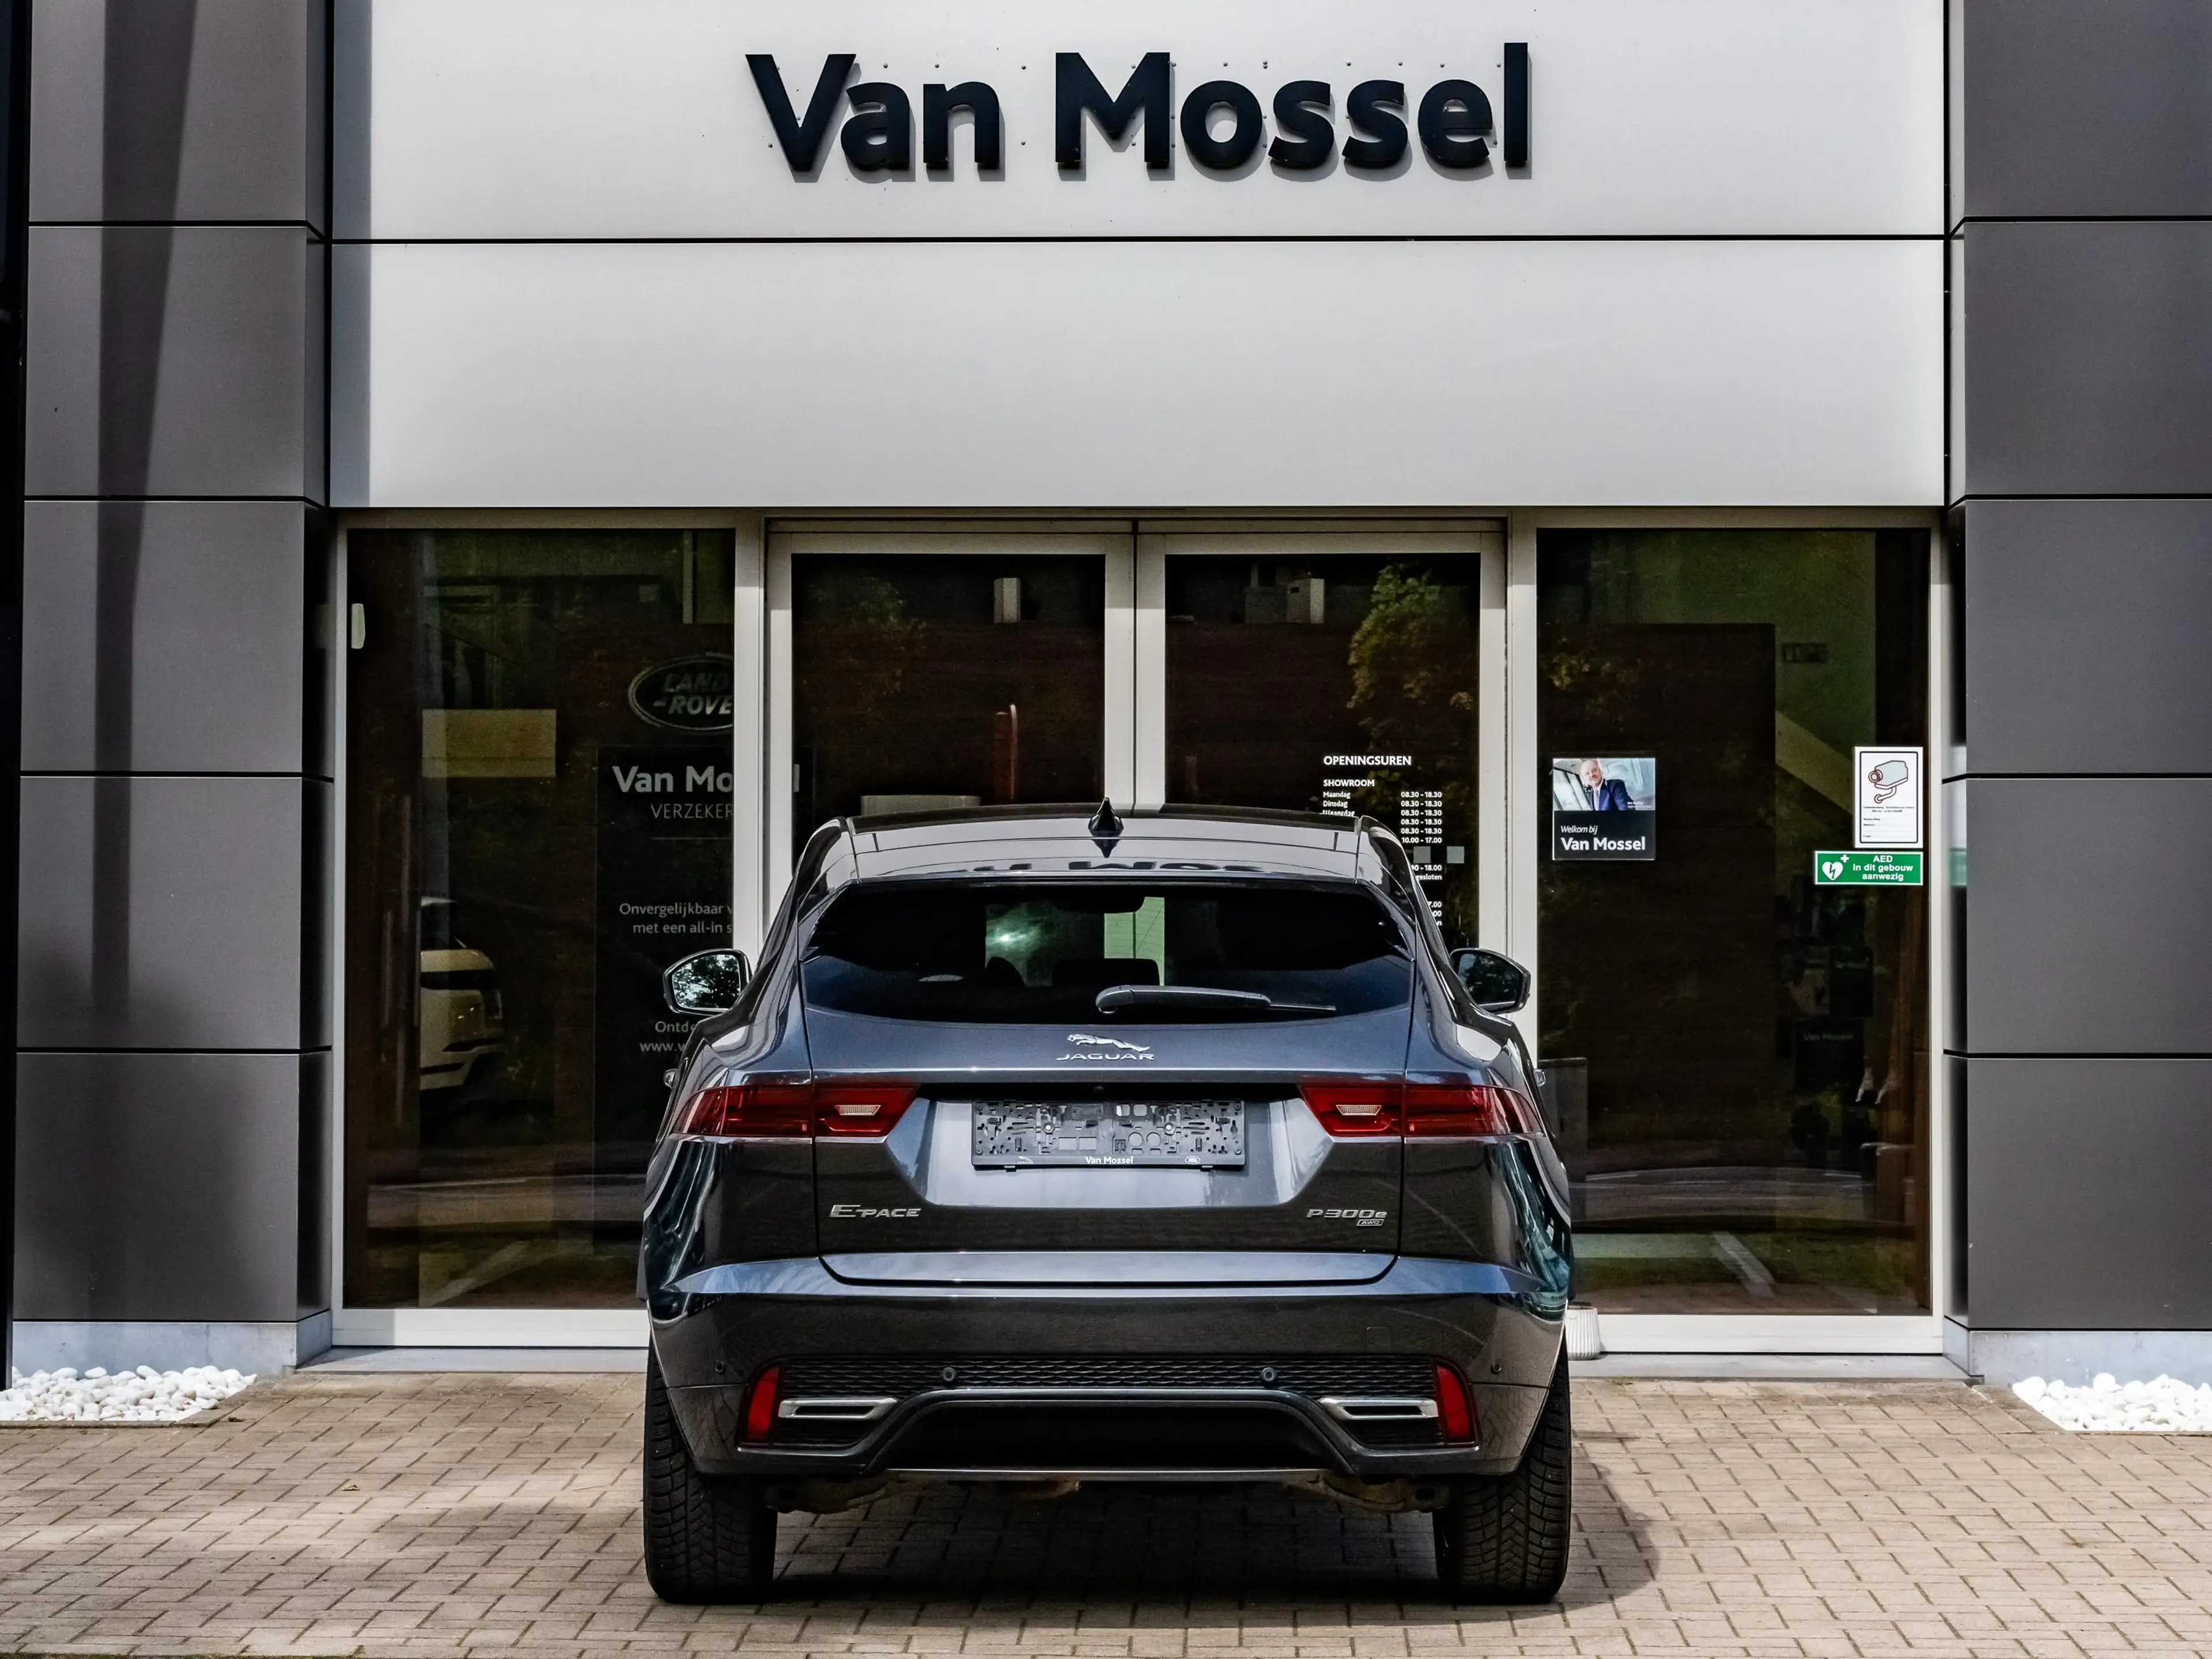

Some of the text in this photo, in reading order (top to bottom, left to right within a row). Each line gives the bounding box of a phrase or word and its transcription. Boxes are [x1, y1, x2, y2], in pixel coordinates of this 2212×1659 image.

[745, 42, 1528, 167] Van Mossel
[663, 672, 729, 693] LAND
[668, 695, 732, 715] ROVE
[1323, 755, 1412, 766] OPENINGSUREN
[612, 766, 674, 793] Van
[1323, 779, 1375, 787] SHOWROOM
[1323, 800, 1348, 808] Dinsdag
[651, 804, 733, 819] VERZEKER
[1560, 825, 1598, 835] Welkom bij
[1560, 836, 1646, 851] Van Mossel
[1873, 855, 1893, 863] AED
[1878, 863, 1914, 874] gebouw
[1862, 872, 1904, 882] aanwezig
[619, 902, 724, 918] Onvergelijkbaar
[633, 923, 659, 934] met
[663, 924, 686, 934] een
[690, 922, 723, 934] all-in
[1056, 1053, 1155, 1061] JAGUAR
[1085, 1156, 1134, 1165] Van Mossel
[1306, 1209, 1387, 1218] P300e
